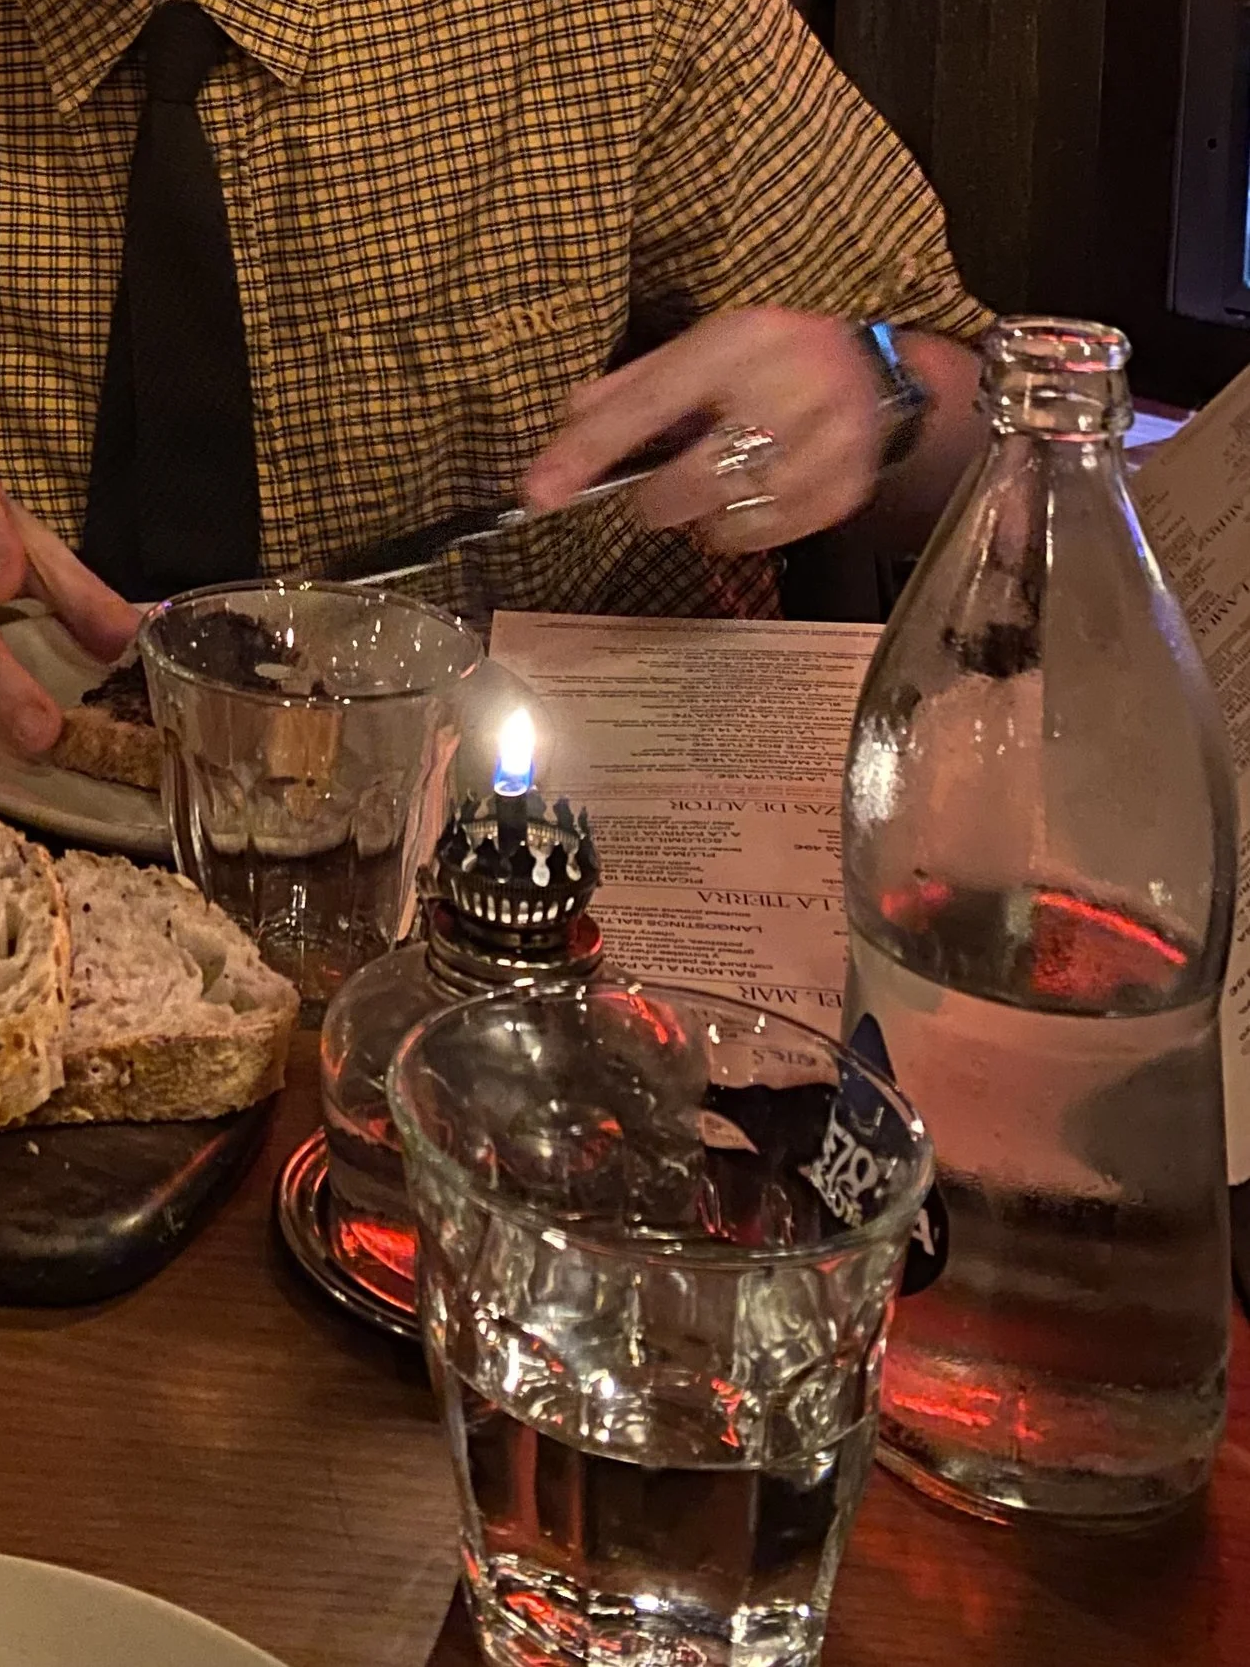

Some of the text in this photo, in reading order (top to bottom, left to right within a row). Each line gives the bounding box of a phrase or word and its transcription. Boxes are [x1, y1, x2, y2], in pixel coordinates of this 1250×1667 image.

[669, 800, 838, 816] ZAS DE AUTOR
[697, 891, 791, 909] TIERRA
[797, 896, 829, 911] LA
[594, 917, 762, 934] LANGOSTINOS SALTE
[739, 986, 843, 1008] EL MAR
